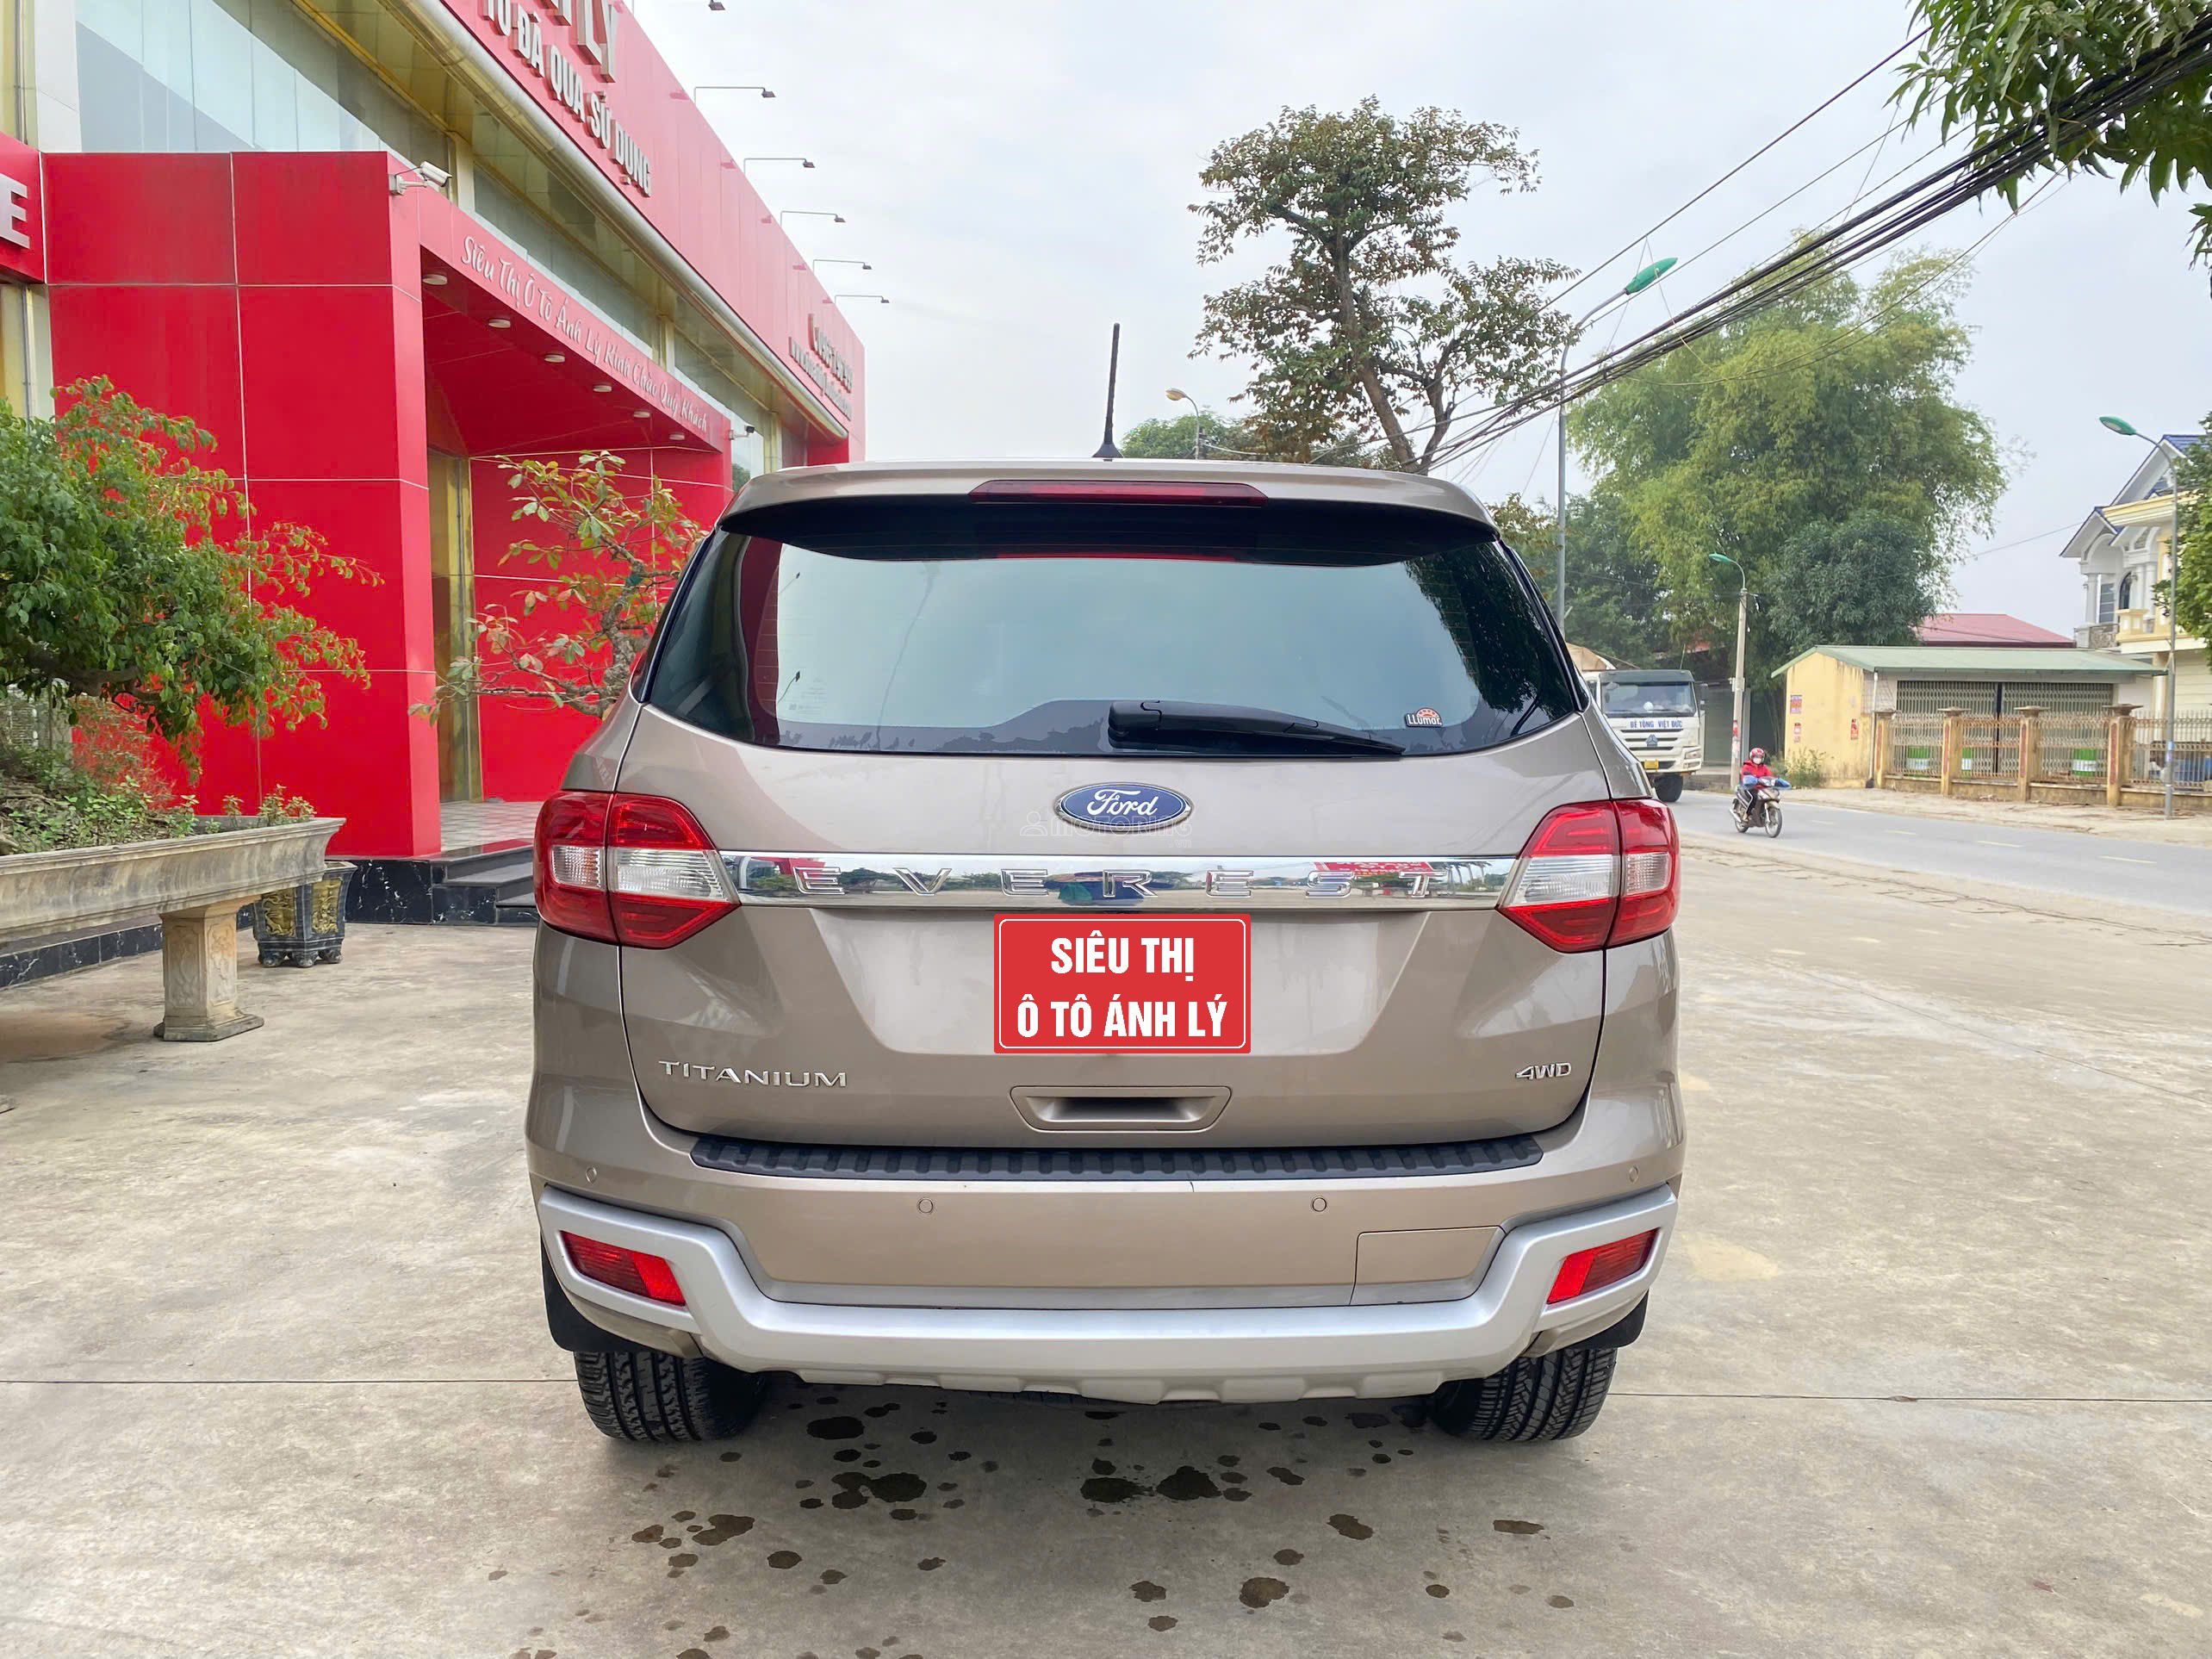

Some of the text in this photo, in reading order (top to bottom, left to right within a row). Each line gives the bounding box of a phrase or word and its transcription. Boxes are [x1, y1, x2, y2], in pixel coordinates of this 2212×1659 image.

[550, 45, 585, 122] QUA
[615, 123, 651, 197] DỤNG
[461, 236, 494, 282] Siêu
[499, 257, 520, 308] Thị
[524, 273, 535, 308] Ô
[538, 289, 552, 321] Tô
[555, 297, 581, 345] Ánh
[585, 327, 600, 365] Lý
[1087, 788, 1159, 816] Ford
[793, 867, 1448, 898] EVEREST
[658, 1060, 847, 1087] TITANIUM
[1515, 1062, 1572, 1080] 4WD
